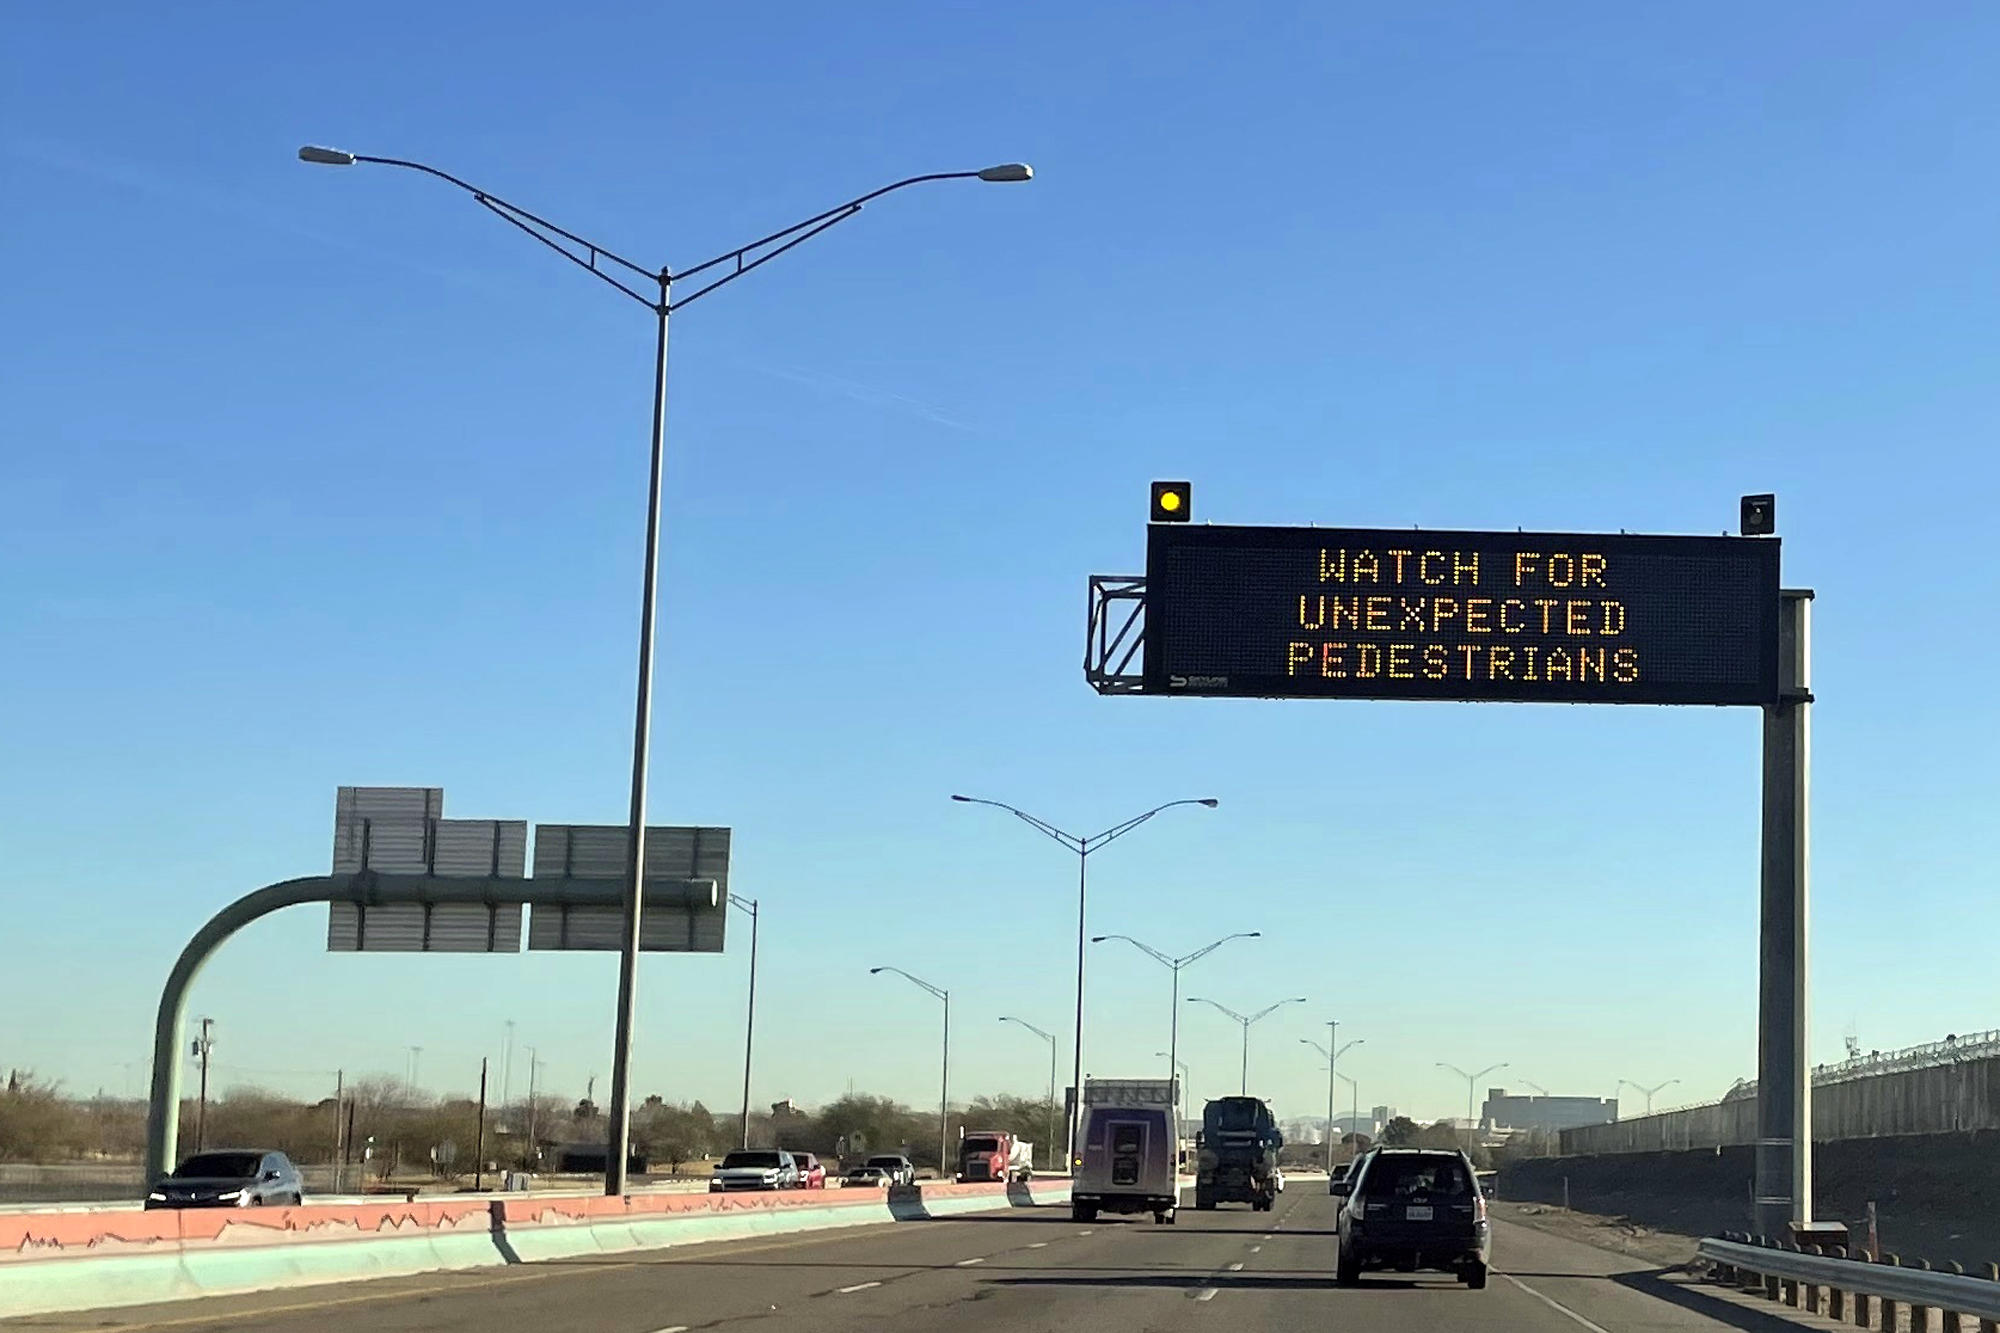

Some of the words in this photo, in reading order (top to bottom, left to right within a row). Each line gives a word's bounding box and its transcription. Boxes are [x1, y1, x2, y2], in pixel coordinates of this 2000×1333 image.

[1319, 547, 1479, 585] WATCH
[1514, 551, 1607, 588] FOR
[1299, 595, 1626, 636] UNEXPECTED
[1287, 641, 1639, 683] PEDESTRIANS
